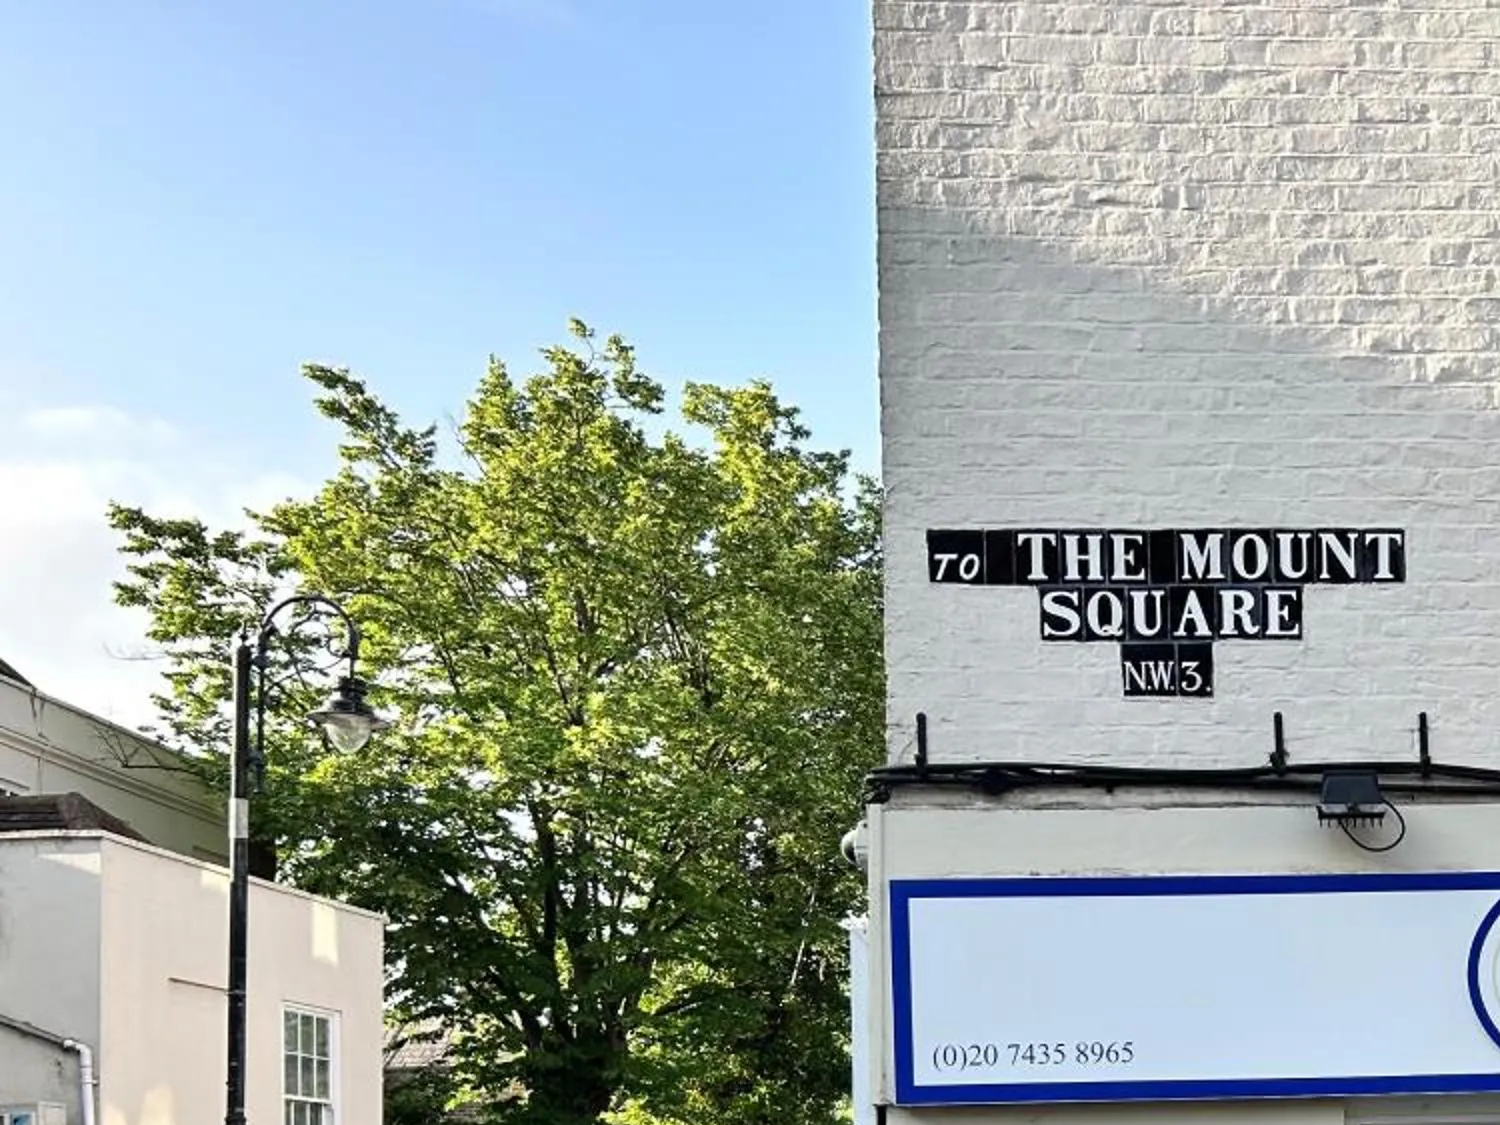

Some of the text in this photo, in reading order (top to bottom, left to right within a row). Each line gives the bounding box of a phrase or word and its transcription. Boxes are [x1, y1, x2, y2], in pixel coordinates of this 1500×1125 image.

[932, 531, 1403, 582] TO THE MOUNT
[1041, 589, 1300, 638] SQUARE
[932, 1041, 1135, 1072] (0)20 7435 8965
